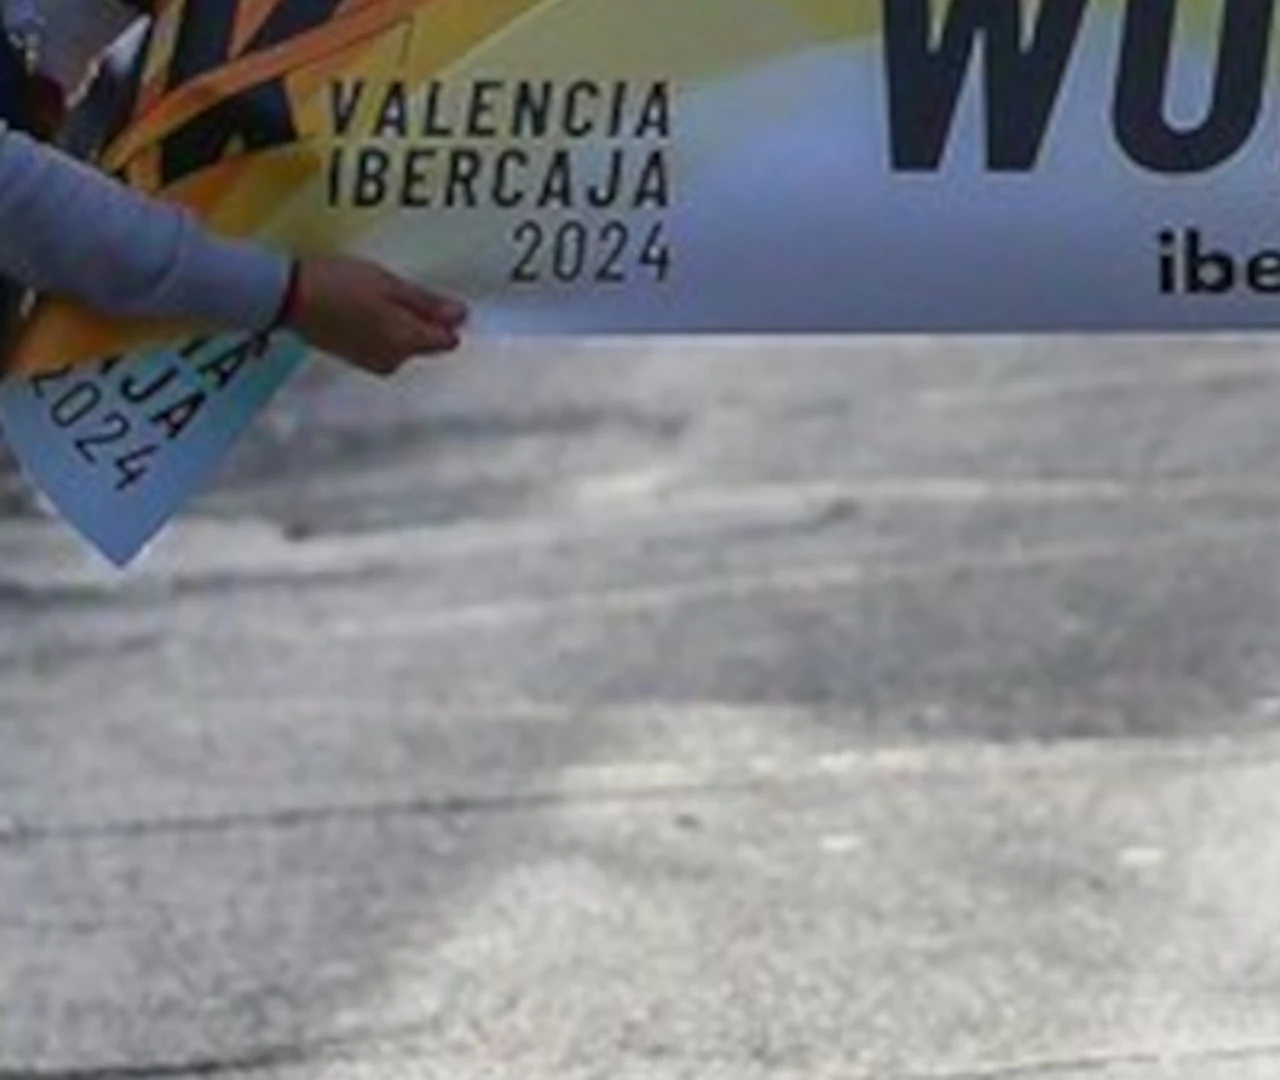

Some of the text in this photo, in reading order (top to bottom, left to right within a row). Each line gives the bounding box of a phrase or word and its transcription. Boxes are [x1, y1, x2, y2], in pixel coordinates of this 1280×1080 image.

[329, 80, 671, 139] VALENCIA
[327, 150, 668, 207] IBERCAJA
[509, 220, 672, 283] 2024
